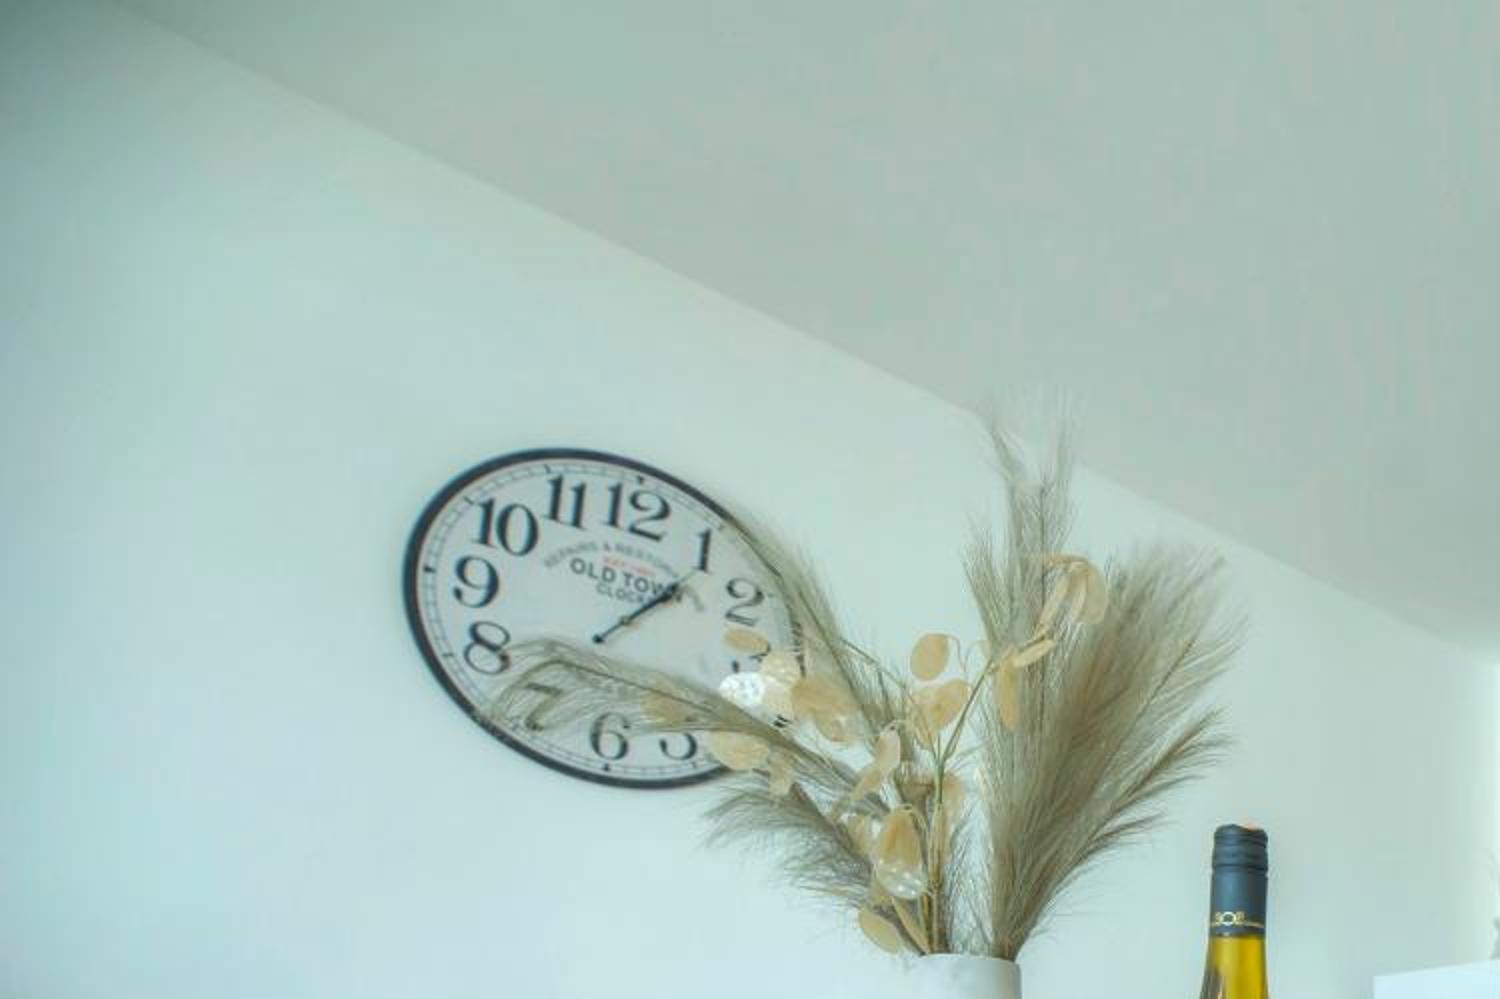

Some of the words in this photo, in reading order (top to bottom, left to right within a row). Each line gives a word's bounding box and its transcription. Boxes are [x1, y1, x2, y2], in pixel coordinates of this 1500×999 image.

[472, 497, 539, 557] 10
[542, 475, 588, 529] 11
[604, 482, 671, 542] 12
[693, 528, 713, 574] 1
[453, 555, 499, 608] 9
[569, 557, 616, 583] OLD
[622, 570, 683, 602] TOW
[724, 576, 765, 627] 2
[463, 620, 511, 675] 8
[589, 711, 630, 761] 6
